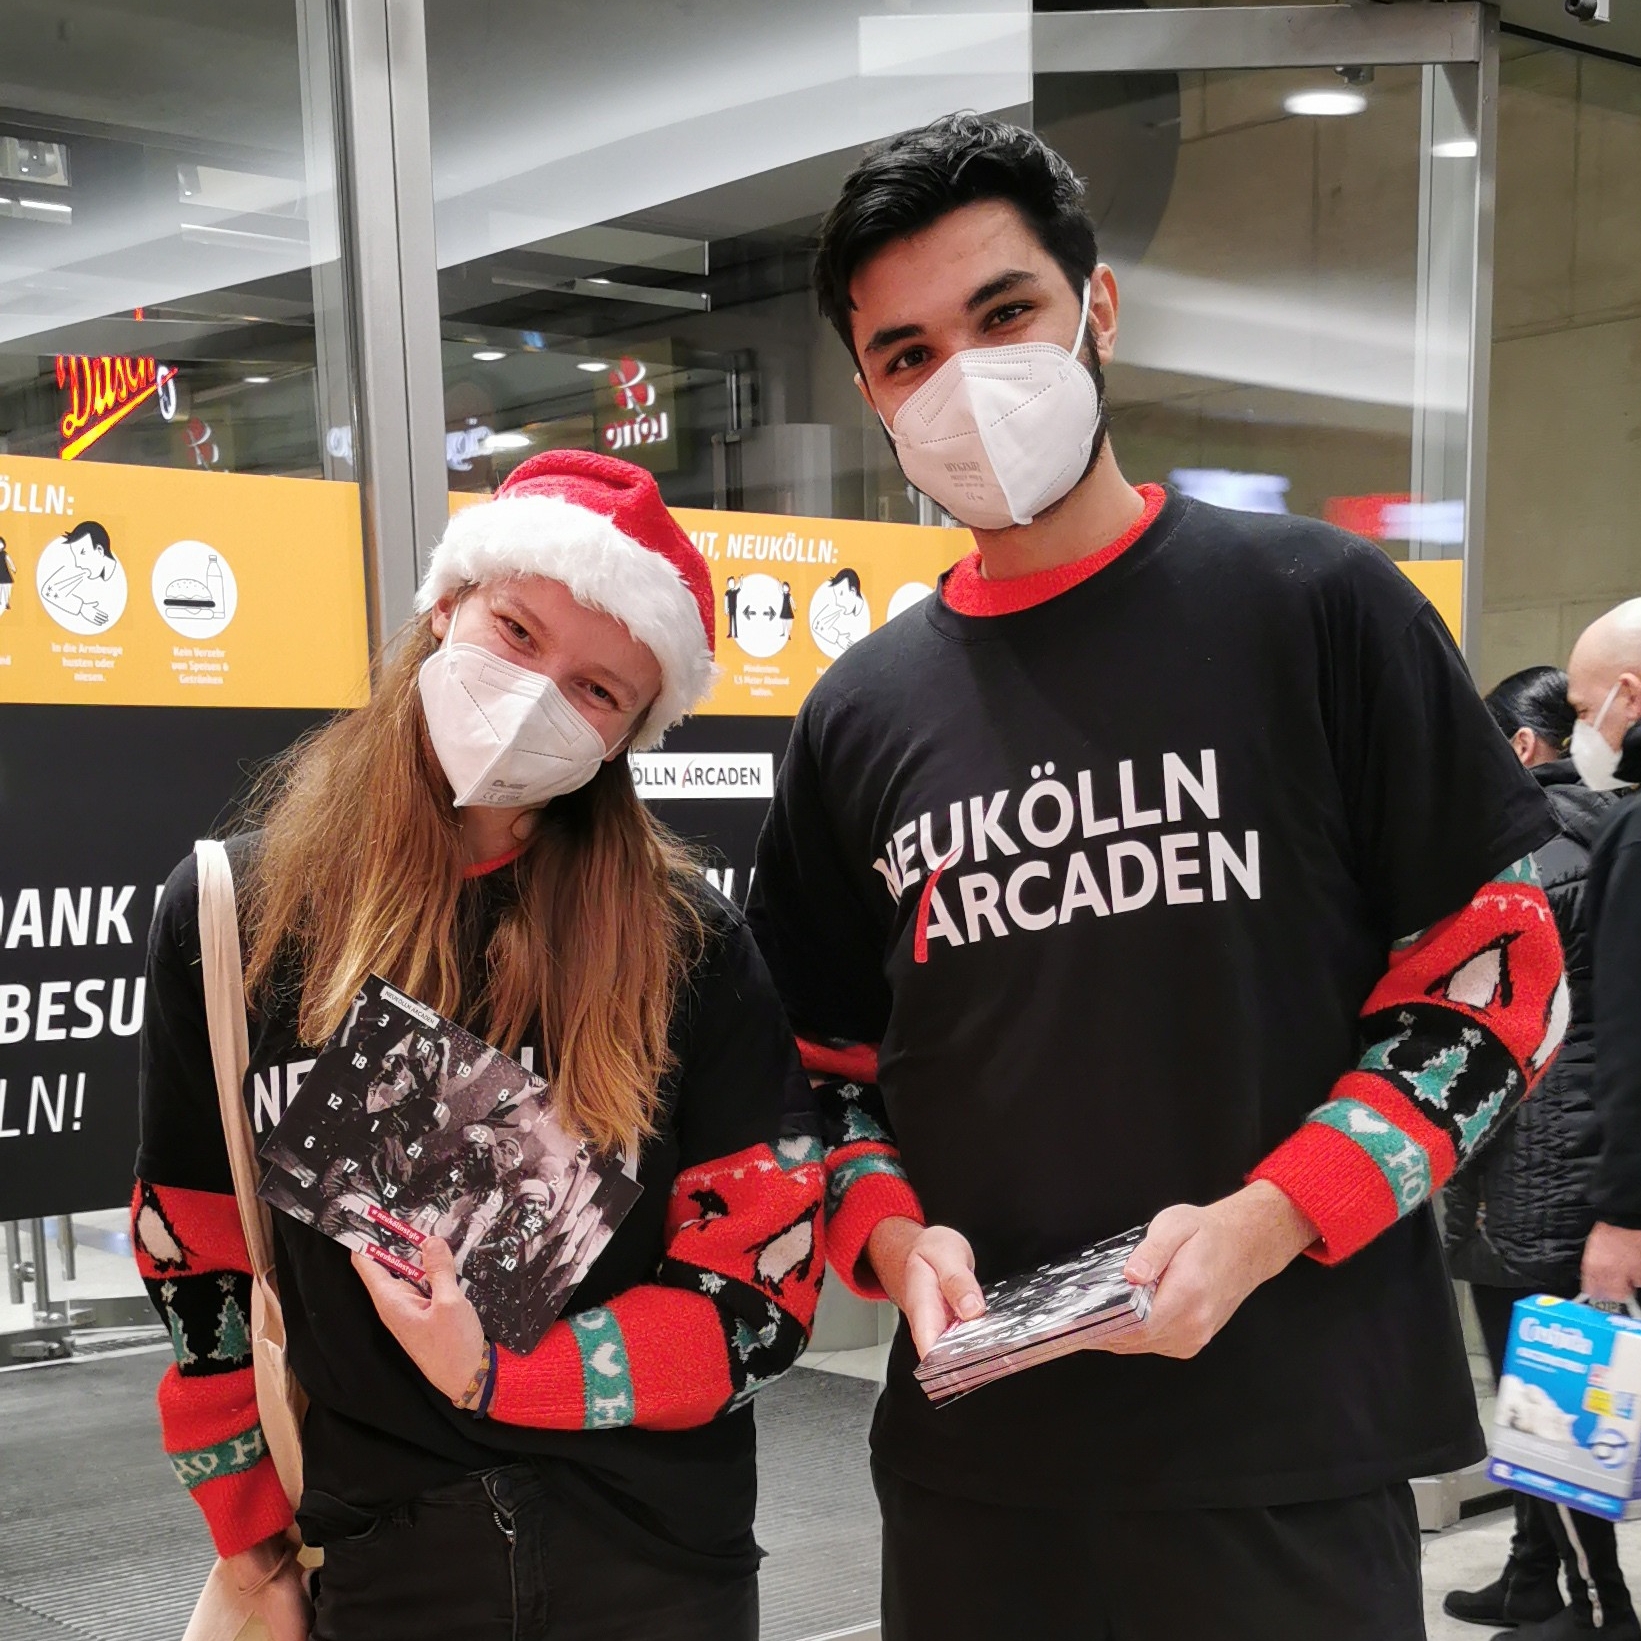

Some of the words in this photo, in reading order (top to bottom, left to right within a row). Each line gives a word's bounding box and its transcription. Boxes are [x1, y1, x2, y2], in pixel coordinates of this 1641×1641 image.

[726, 532, 839, 564] NEUKÖLLN:
[681, 759, 760, 788] ARCADEN
[872, 749, 1220, 906] NEUKÖLLN
[914, 829, 1261, 963] ARCADEN
[0, 885, 136, 948] ANK
[378, 1014, 389, 1027] 3
[417, 1037, 433, 1054] 16
[352, 1053, 367, 1069] 18
[457, 1062, 471, 1078] 19
[327, 1093, 343, 1110] 12
[498, 1089, 509, 1101] 8
[433, 1103, 447, 1118] 11
[371, 1120, 379, 1132] 1
[304, 1136, 316, 1149] 6
[469, 1126, 487, 1143] 23
[407, 1142, 422, 1158] 21
[343, 1158, 358, 1173] 17
[383, 1183, 397, 1198] 13
[501, 1255, 516, 1271] 10
